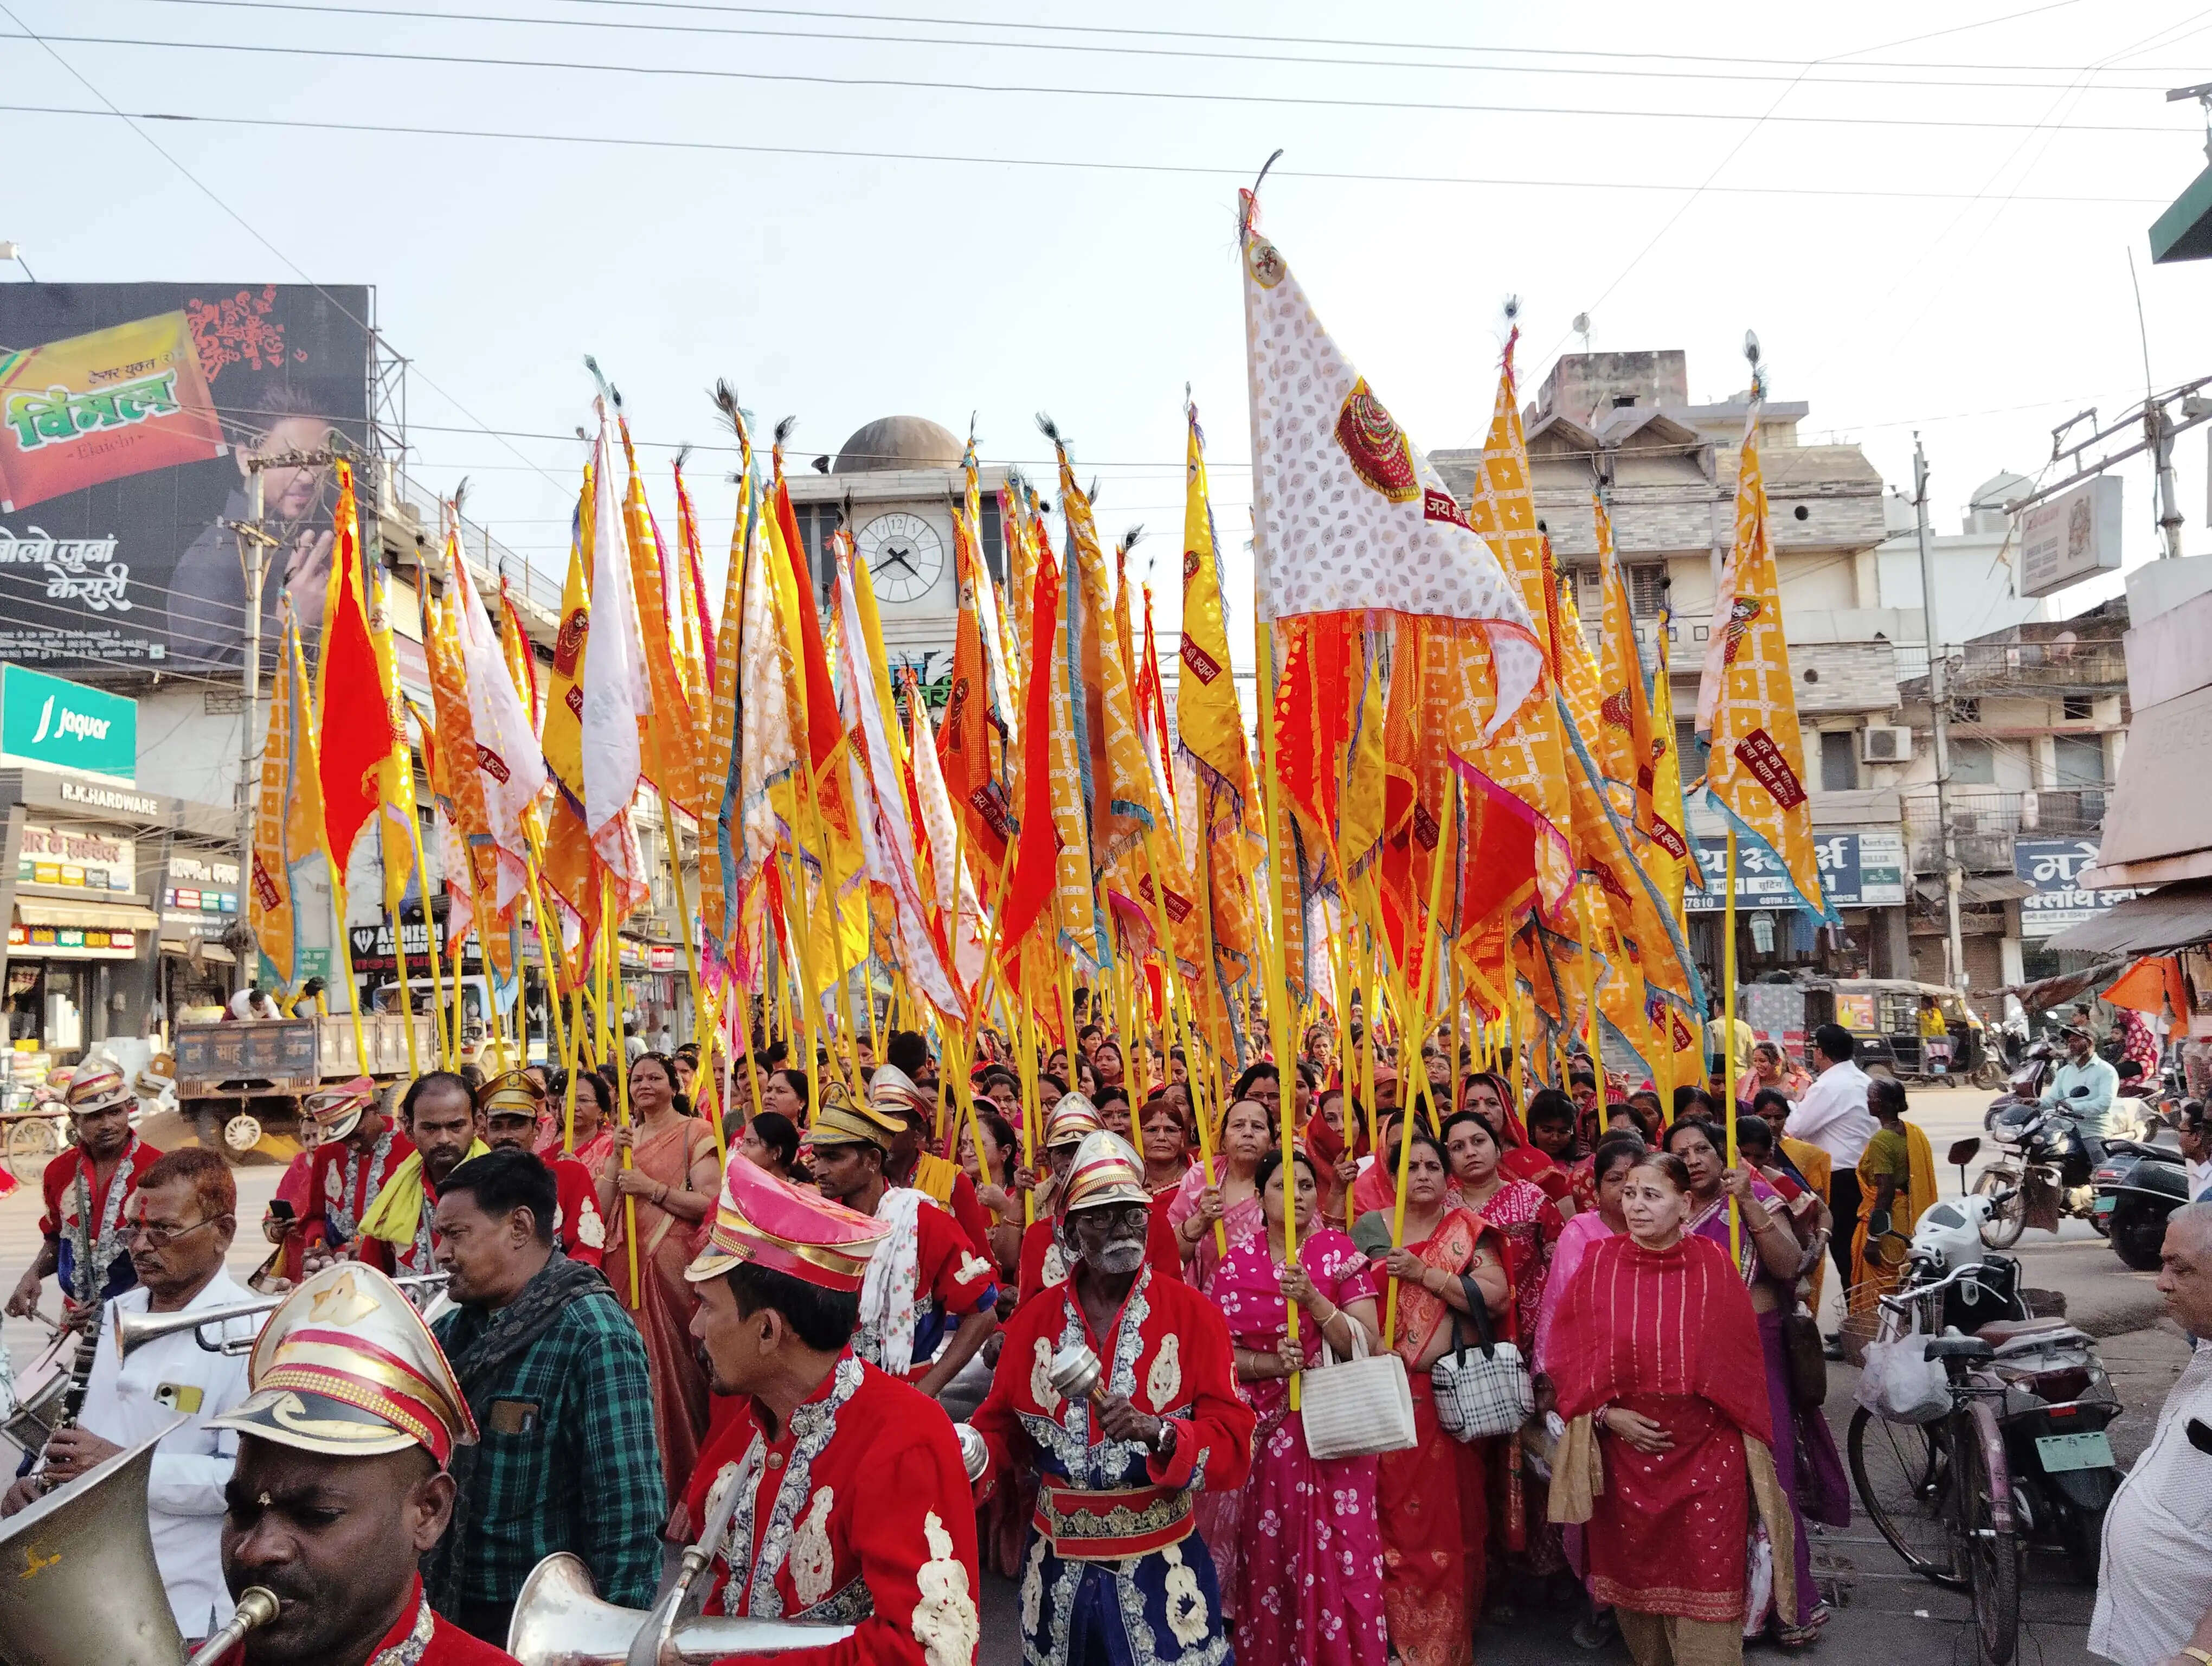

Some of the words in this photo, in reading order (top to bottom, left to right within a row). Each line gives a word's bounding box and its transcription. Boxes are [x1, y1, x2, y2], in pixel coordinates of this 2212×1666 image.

[8, 370, 179, 448] विमल
[1426, 497, 1450, 517] जय
[874, 524, 886, 535] 11
[891, 518, 903, 530] 12
[57, 533, 119, 573] जुबां
[44, 562, 133, 611] केसरी
[1193, 656, 1217, 681] श्याम
[1754, 738, 1772, 755] हारे
[1769, 753, 1784, 769] का
[1756, 759, 1776, 781] श्याम
[973, 791, 989, 809] जय
[1661, 832, 1685, 856] श्याम
[1683, 897, 1714, 908] 7810
[2023, 884, 2095, 908] क्लॉथ
[377, 941, 443, 955] GAMENS
